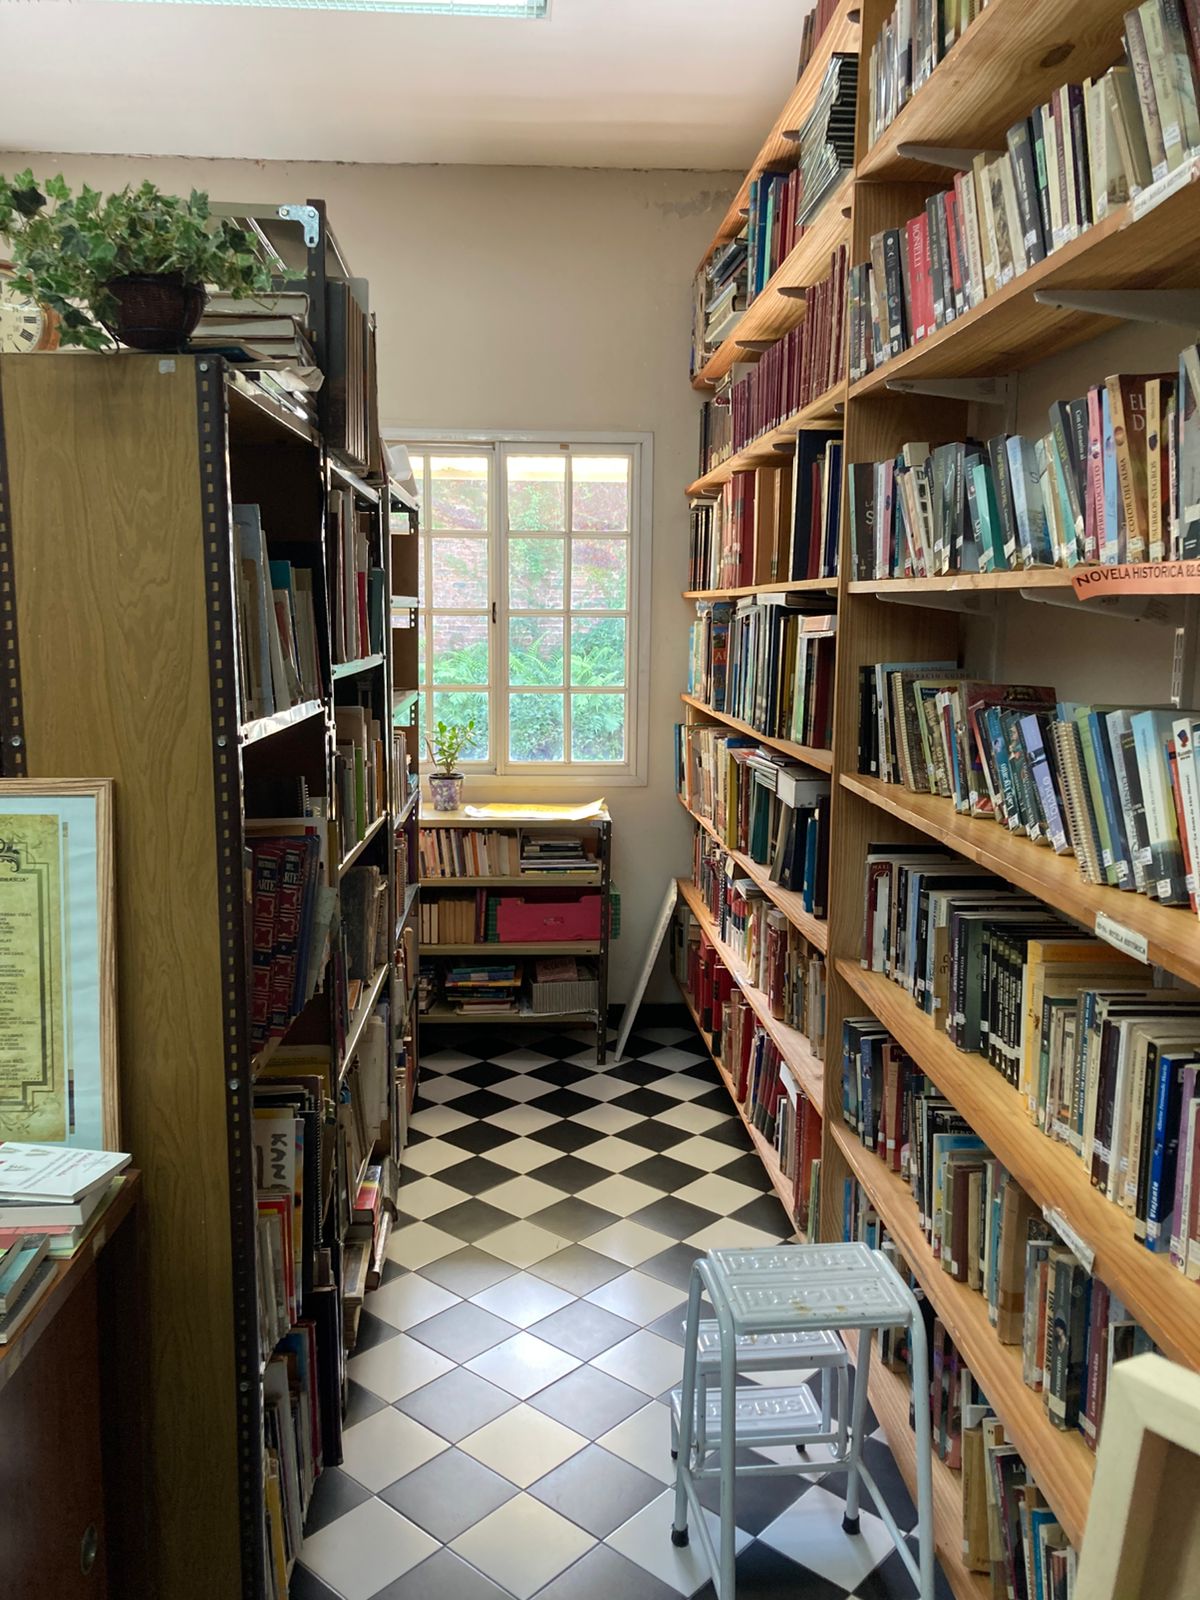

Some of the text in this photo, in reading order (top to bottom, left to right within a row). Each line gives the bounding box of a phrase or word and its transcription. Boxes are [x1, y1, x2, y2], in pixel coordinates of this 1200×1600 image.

[912, 223, 921, 268] BONELLI
[1094, 465, 1102, 502] OCULTO
[1120, 457, 1129, 482] ALMA
[1150, 461, 1158, 499] NEGROS
[1122, 483, 1132, 500] DEL
[1125, 501, 1136, 531] COLOR
[1076, 567, 1131, 587] NOVELA
[1132, 564, 1184, 579] HISTORICA
[257, 879, 275, 891] ARTE
[1149, 1181, 1159, 1219] Viajante
